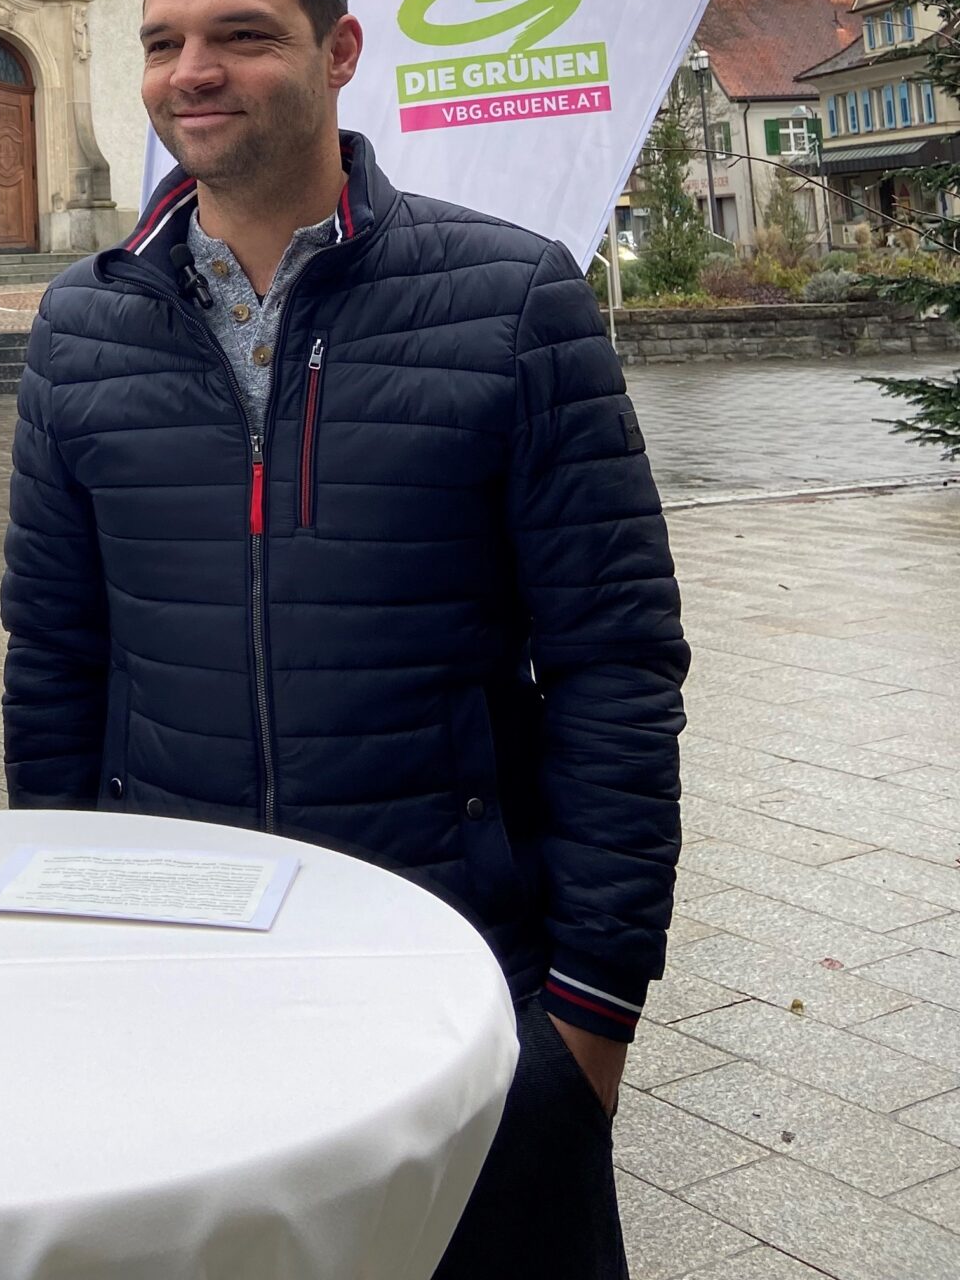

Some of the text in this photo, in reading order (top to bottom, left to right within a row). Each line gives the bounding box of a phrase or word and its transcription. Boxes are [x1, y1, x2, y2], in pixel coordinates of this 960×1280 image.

[404, 50, 600, 96] DIE GRÜNEN
[441, 91, 604, 124] VBG.GRUENE.AT
